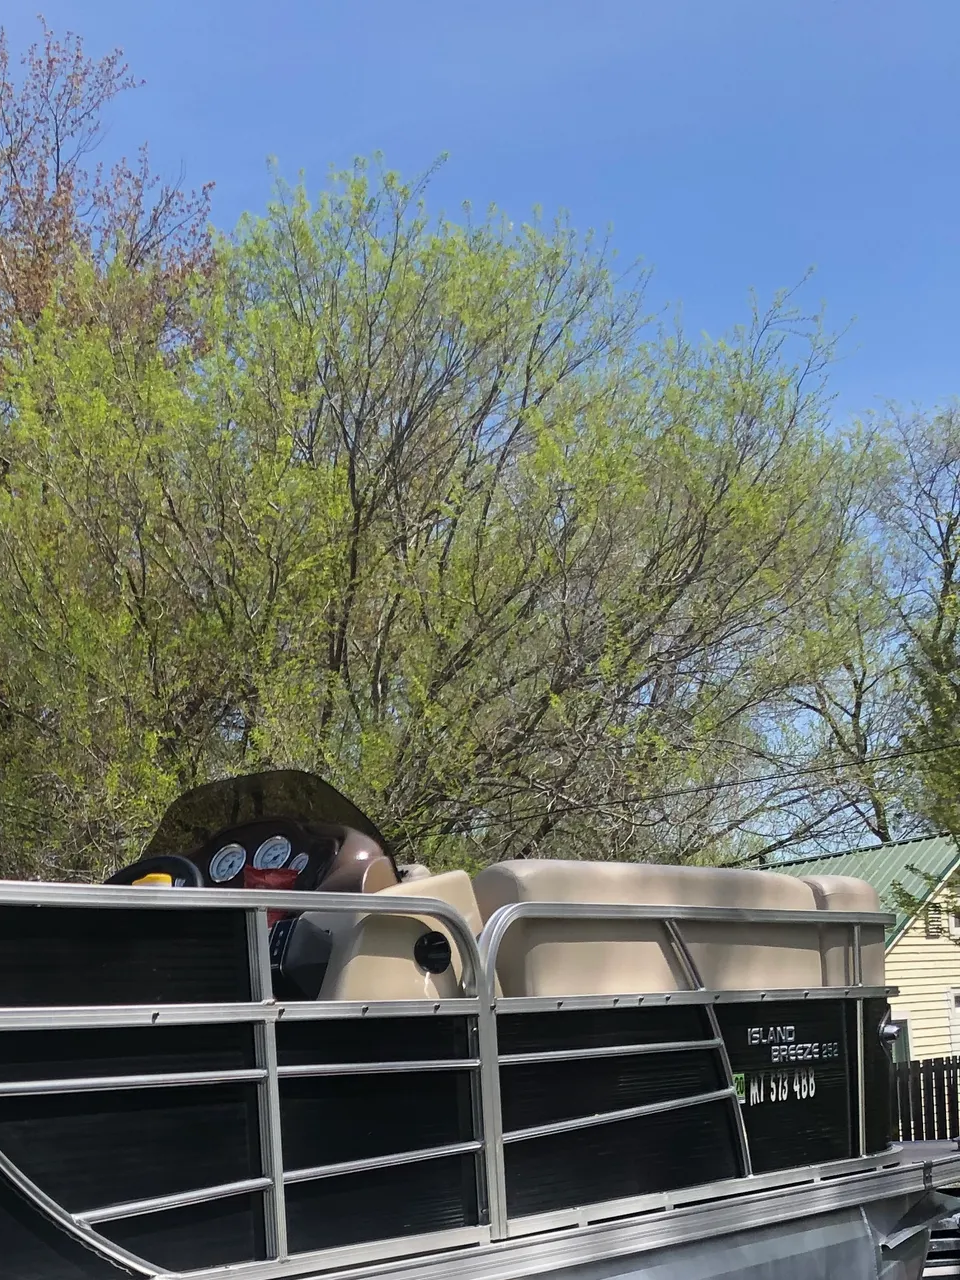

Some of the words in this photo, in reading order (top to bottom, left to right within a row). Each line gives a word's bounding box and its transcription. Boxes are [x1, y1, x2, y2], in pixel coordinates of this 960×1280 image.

[747, 1025, 795, 1045] ISLAND
[771, 1043, 820, 1063] BREEZE
[750, 1073, 764, 1107] MT
